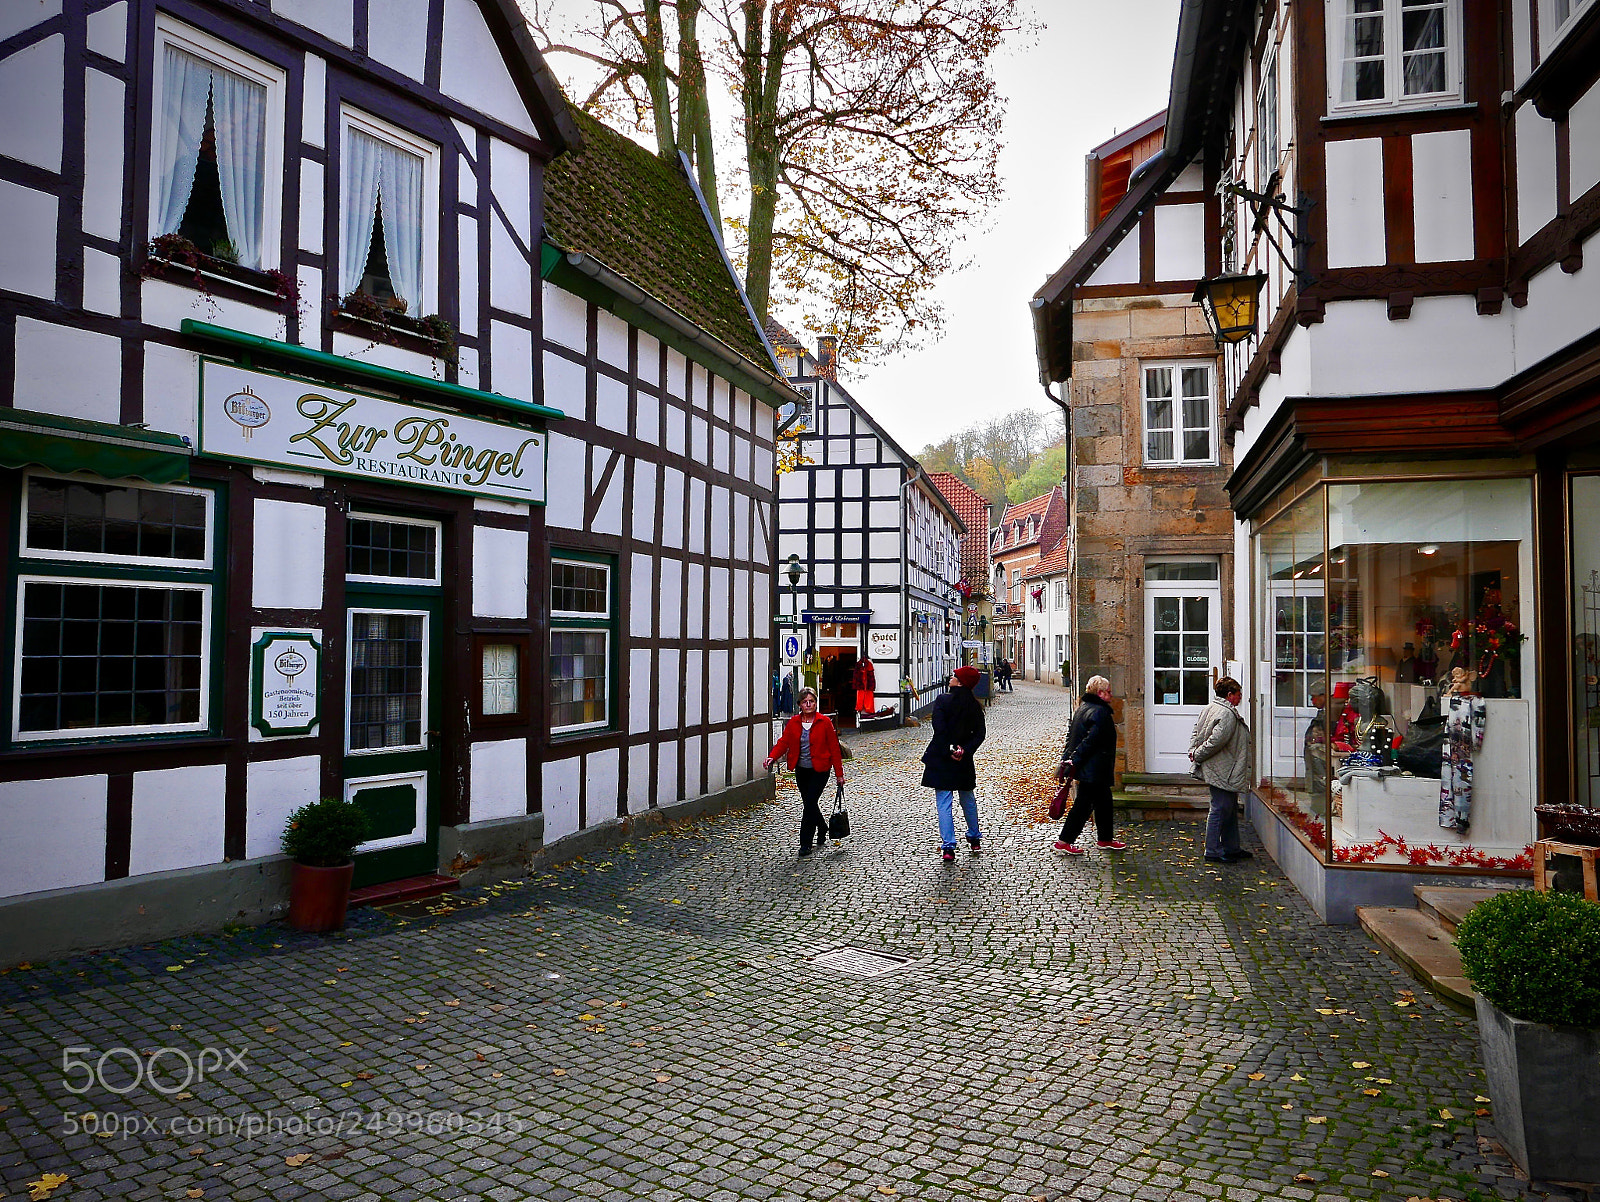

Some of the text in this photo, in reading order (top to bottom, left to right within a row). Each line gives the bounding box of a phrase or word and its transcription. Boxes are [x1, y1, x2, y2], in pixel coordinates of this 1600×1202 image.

[290, 393, 540, 486] Zur Pingel
[355, 456, 463, 486] RESTAURANT
[871, 632, 897, 644] Hotel
[269, 710, 309, 719] 150 Jahren
